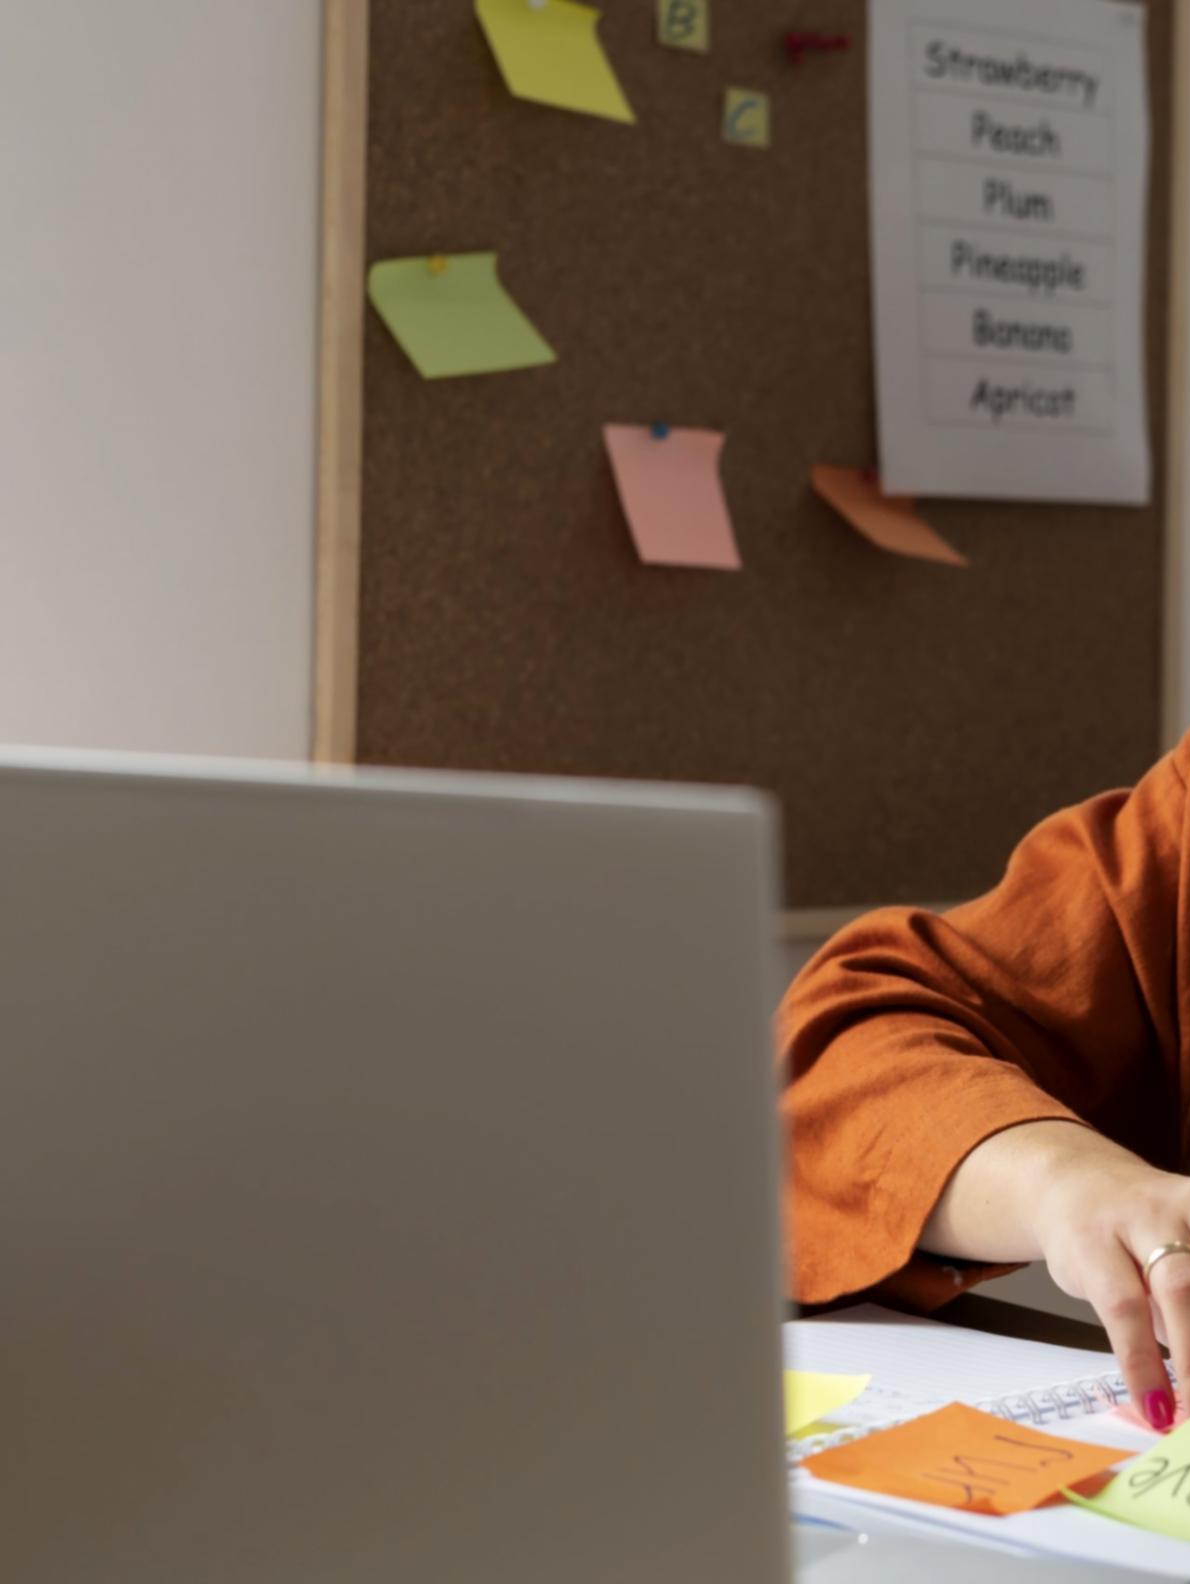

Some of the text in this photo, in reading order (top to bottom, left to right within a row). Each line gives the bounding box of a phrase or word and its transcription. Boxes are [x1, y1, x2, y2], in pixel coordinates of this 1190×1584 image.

[668, 0, 697, 38] B
[924, 38, 1098, 110] Strawberry
[726, 98, 761, 138] C
[970, 109, 1062, 157] Peach
[983, 176, 1055, 220] Plum
[951, 239, 1086, 296] Pineapple
[973, 307, 1074, 354] Banana
[969, 377, 1076, 424] Apricot
